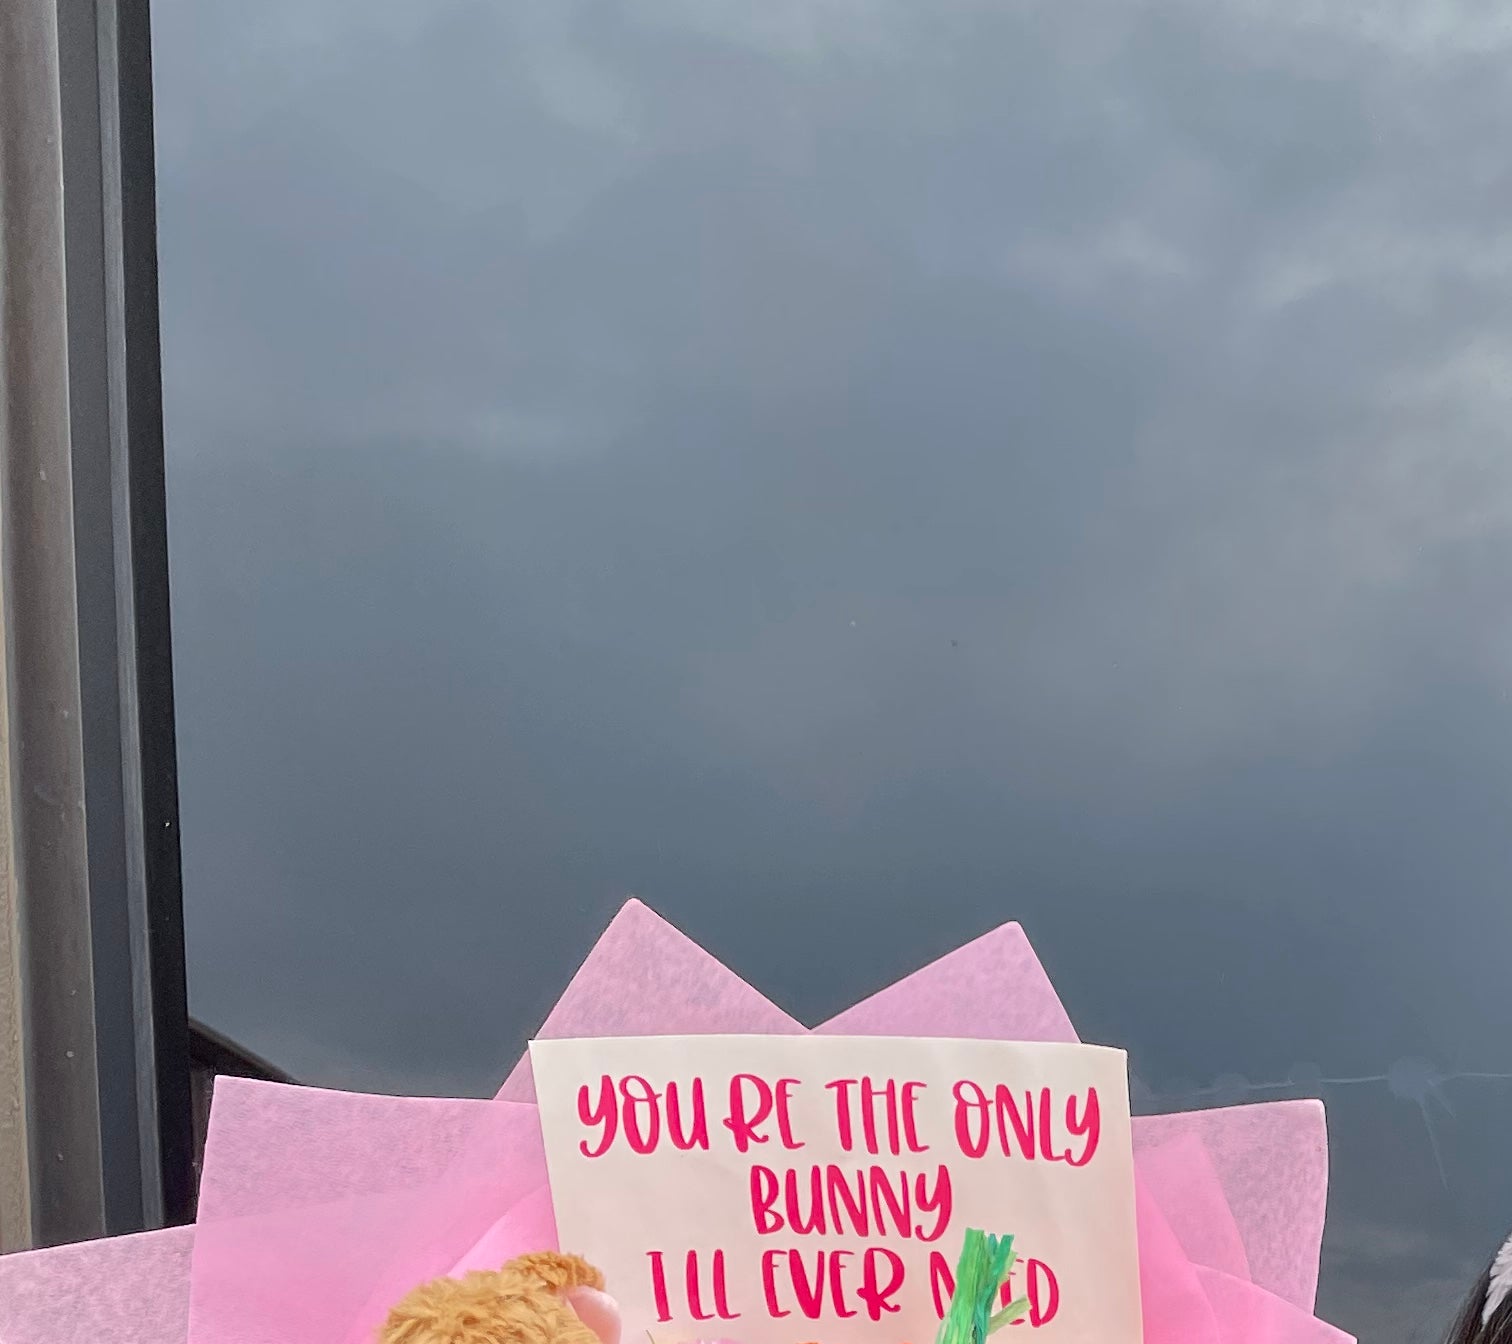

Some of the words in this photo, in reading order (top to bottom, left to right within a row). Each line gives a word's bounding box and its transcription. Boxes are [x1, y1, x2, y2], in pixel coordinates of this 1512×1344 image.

[825, 1076, 930, 1156] THE
[952, 1079, 1101, 1168] ONLY
[749, 1163, 953, 1243] BUNNY
[761, 1247, 906, 1323] EVER
[929, 1250, 1060, 1328] NED
